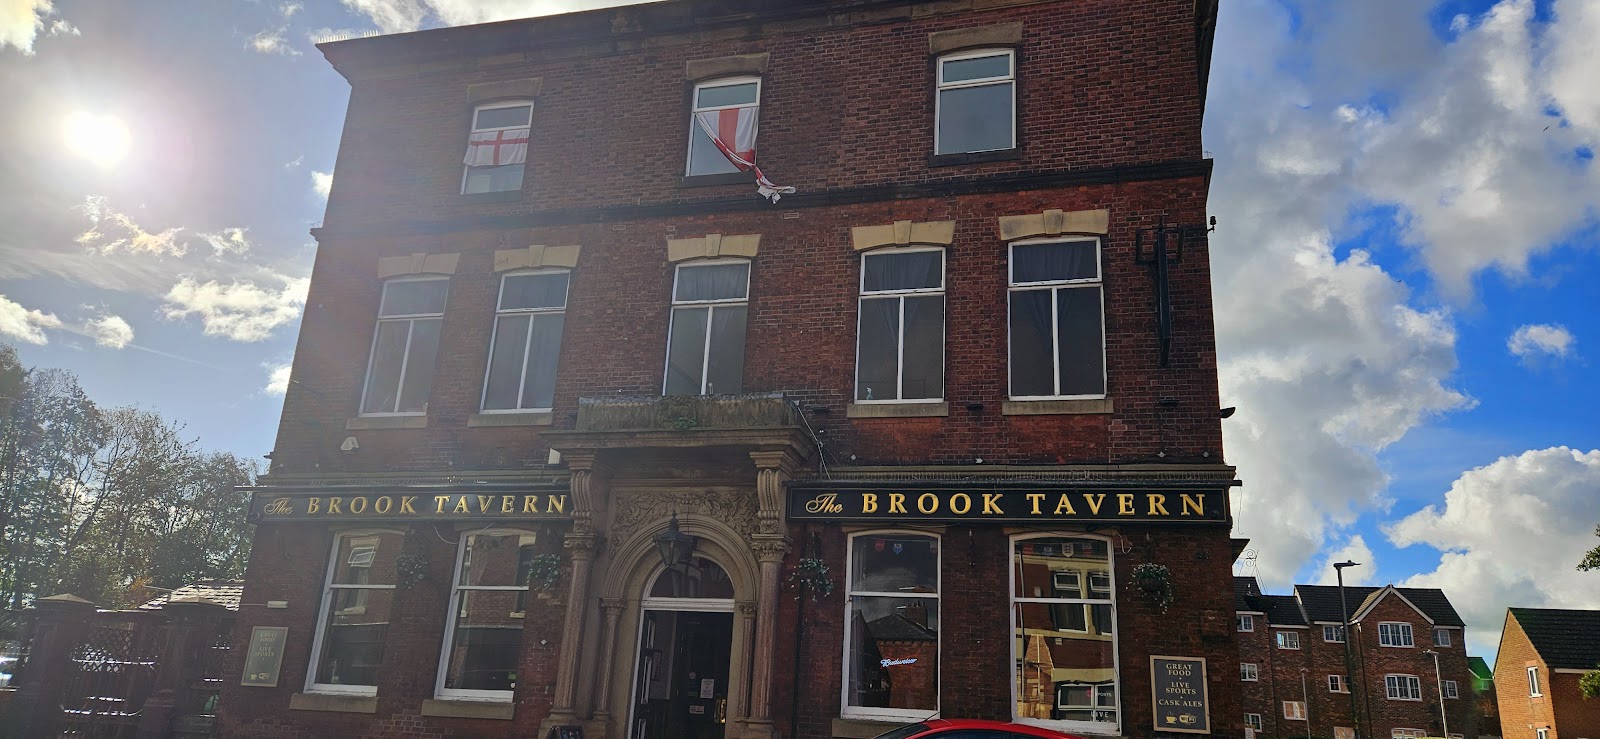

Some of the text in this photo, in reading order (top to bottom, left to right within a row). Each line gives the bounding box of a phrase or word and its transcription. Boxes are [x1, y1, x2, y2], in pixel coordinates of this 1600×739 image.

[263, 495, 568, 515] The BROOK TAVERN
[805, 493, 1206, 516] The BROOK TAVERN
[880, 658, 918, 667] Budweiser
[1165, 687, 1197, 695] SPORTS
